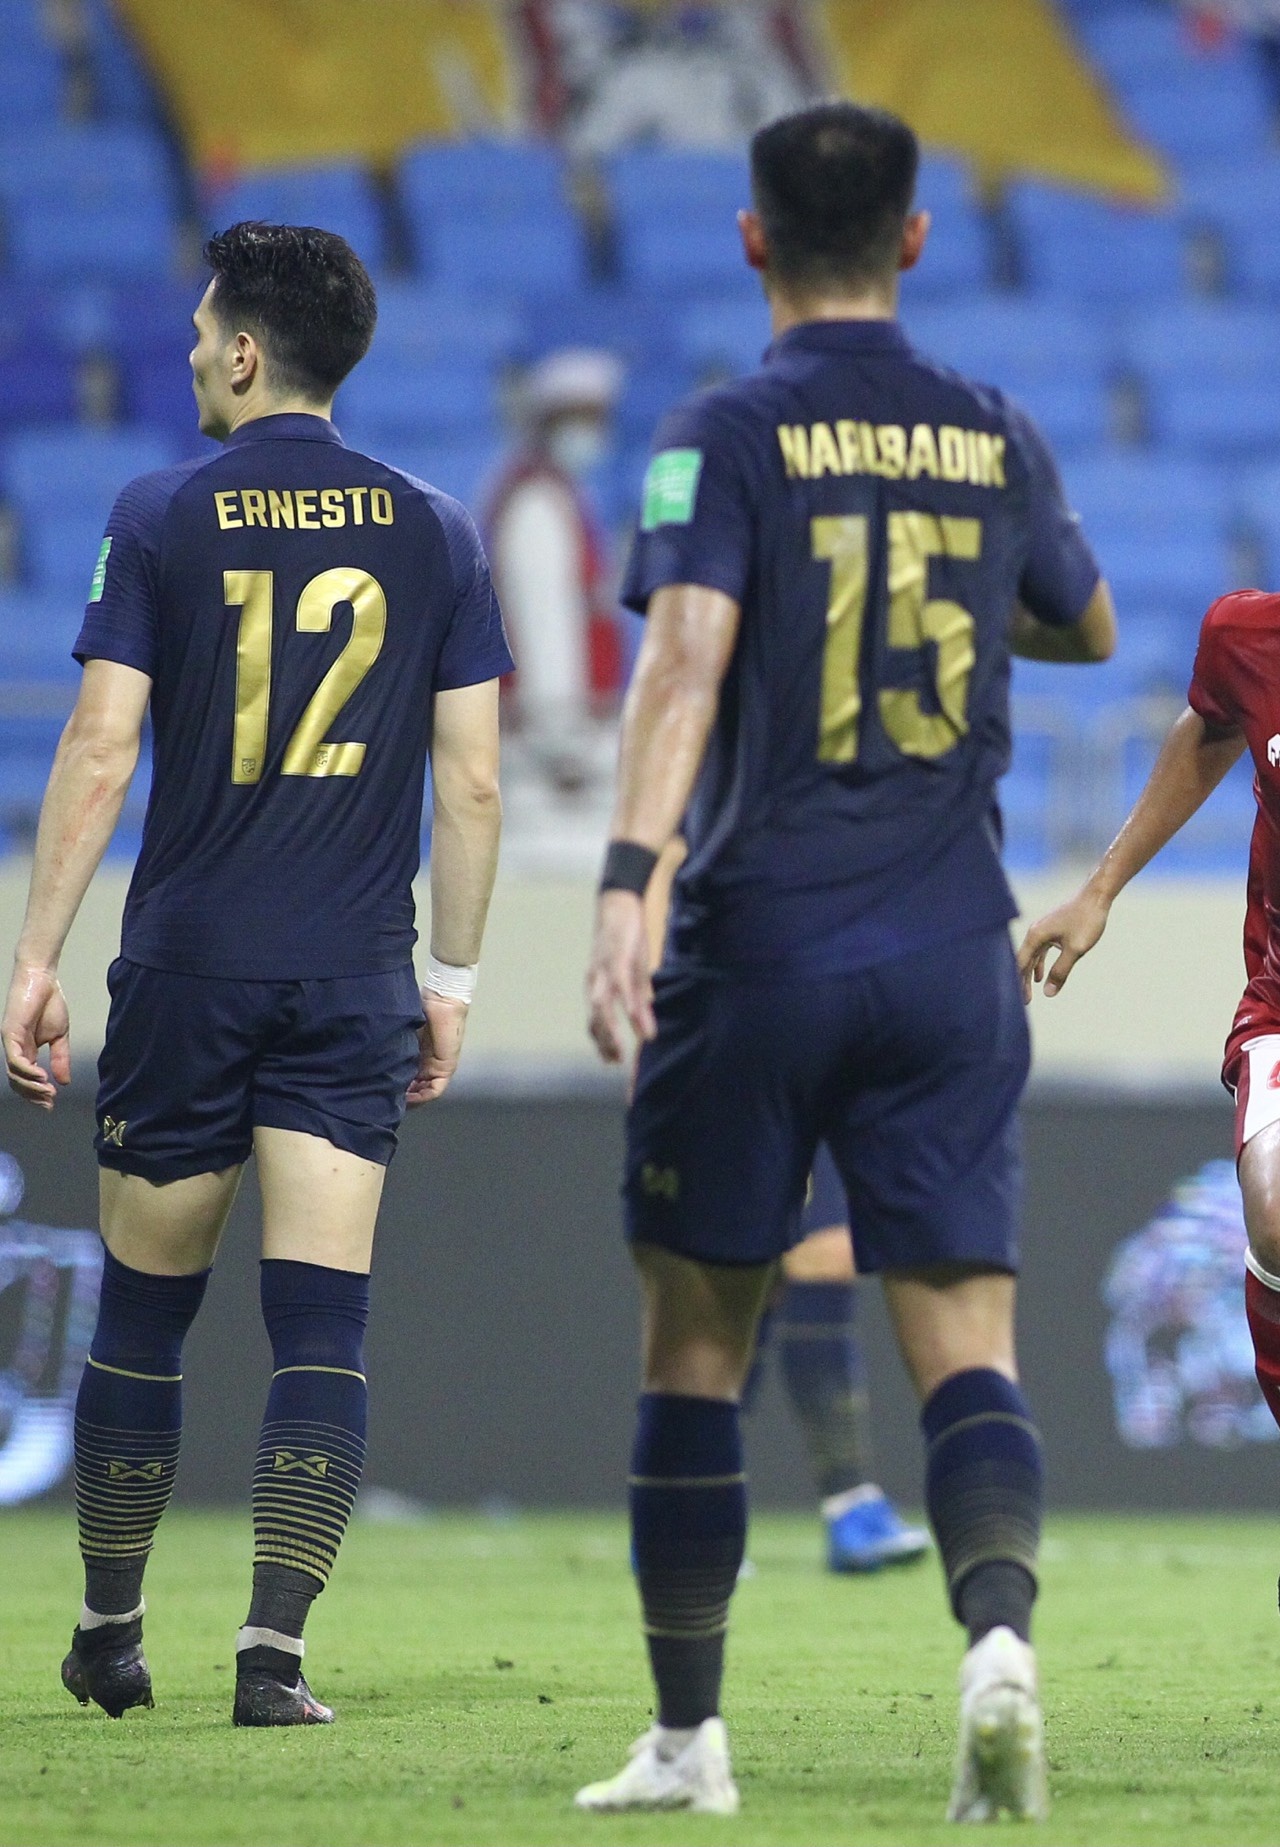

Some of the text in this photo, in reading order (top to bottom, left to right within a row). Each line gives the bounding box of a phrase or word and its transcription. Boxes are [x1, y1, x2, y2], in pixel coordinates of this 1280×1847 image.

[213, 487, 394, 530] ERNESTO
[222, 566, 388, 785] 12
[810, 510, 982, 764] 15
